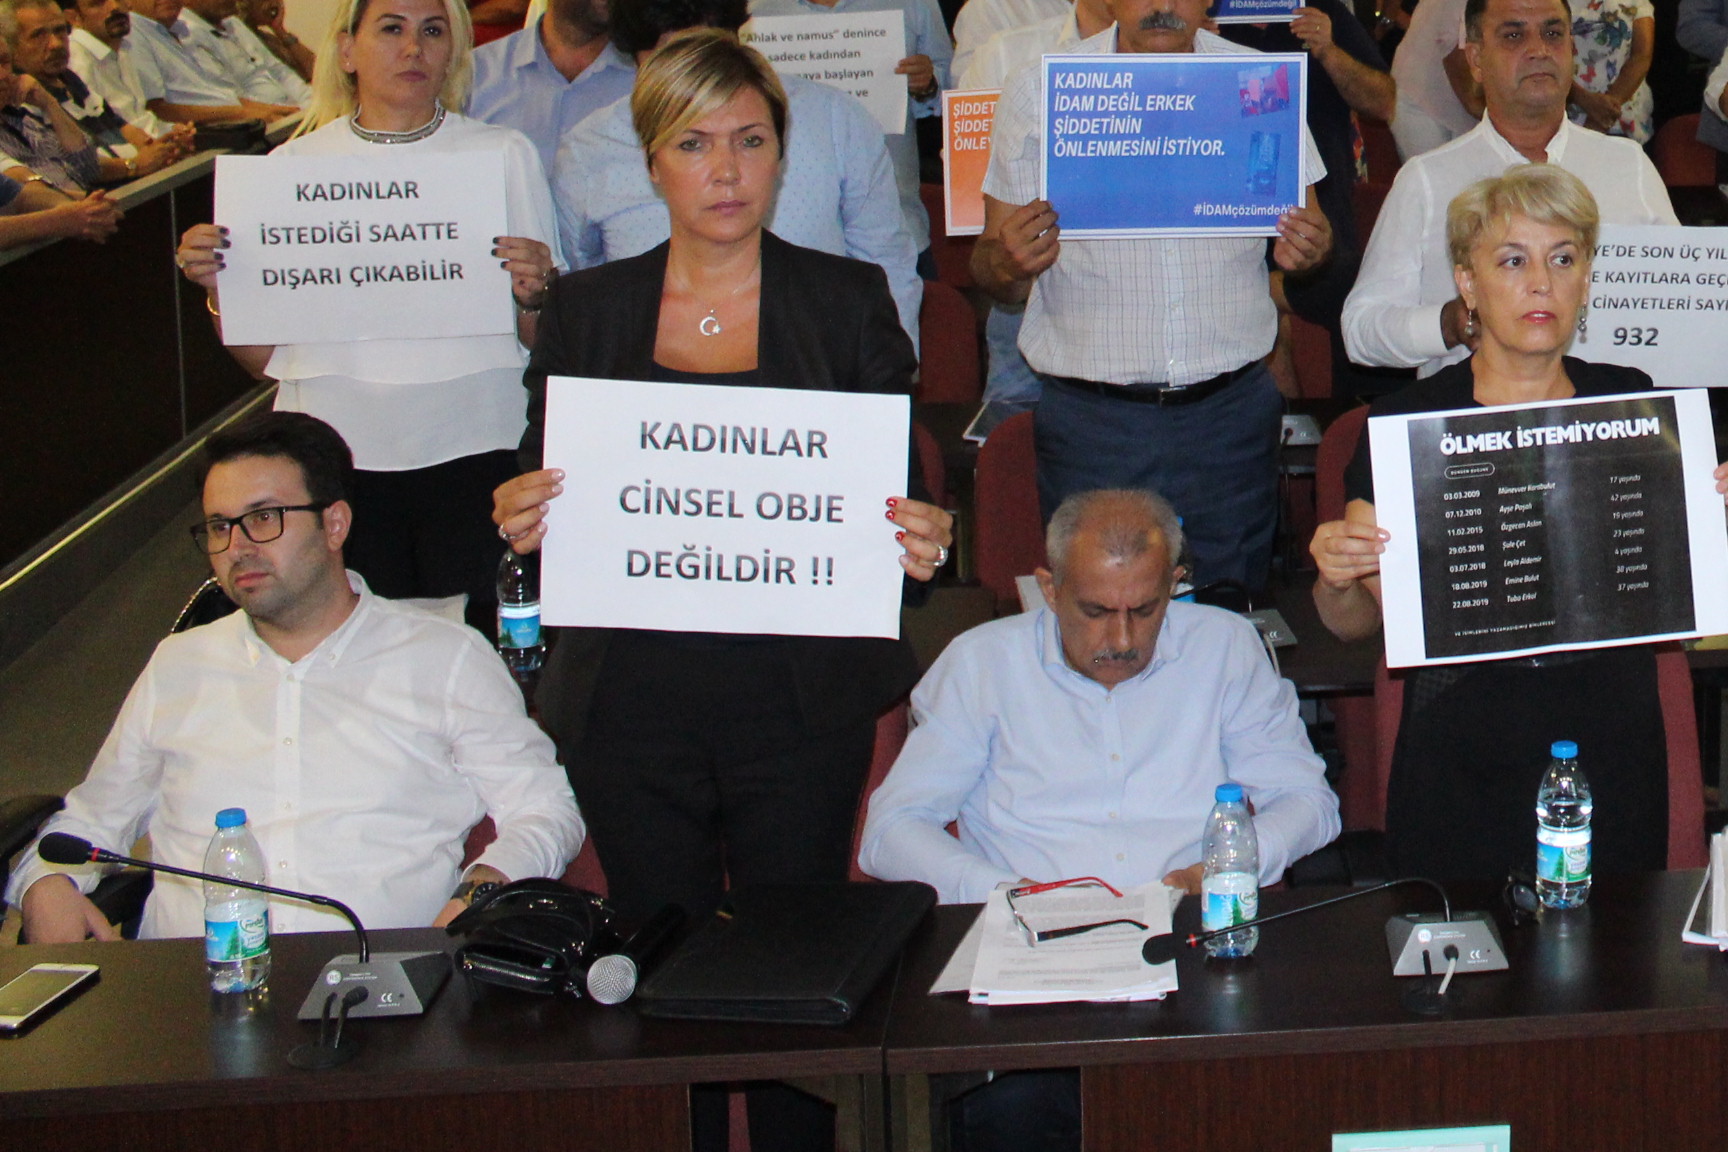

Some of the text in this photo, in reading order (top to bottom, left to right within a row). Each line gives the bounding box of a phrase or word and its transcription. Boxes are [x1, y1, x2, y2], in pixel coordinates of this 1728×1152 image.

[781, 32, 793, 42] ve
[843, 27, 887, 39] denince
[768, 49, 861, 62] sadece kadından
[824, 68, 874, 81] başlayan
[1054, 72, 1133, 89] KADINLAR
[855, 90, 869, 98] ve
[1054, 91, 1196, 112] İDAM DEĞİL ERKEK
[1054, 115, 1142, 138] ŞİDDETİNİN
[1054, 136, 1225, 157] ÖNLENMESİNİ İSTİYOR.
[296, 181, 420, 202] KADINLAR
[261, 221, 459, 245] İSTEDİĞİ SAATTE
[1641, 246, 1674, 259] SON
[1680, 244, 1701, 262] ÜÇ
[263, 259, 464, 289] DIŞARI ÇIKABİLİR
[1605, 271, 1691, 285] KAYITLARA
[1592, 295, 1691, 311] CİNAYETLERİ
[1613, 327, 1659, 346] 932
[640, 421, 828, 458] KADINLAR
[1439, 416, 1660, 456] ÖLMEK İSTEMİYORUM
[619, 479, 844, 523] CİNSEL OBJE
[1444, 489, 1480, 501] 03.03.2009
[1445, 508, 1482, 519] 07.12.2010
[1447, 526, 1483, 537] 11.02.2015
[627, 544, 834, 585] DEĞİLDİR !!
[1449, 562, 1486, 573] 03.07.2018
[1452, 598, 1489, 609] 22.08.2019
